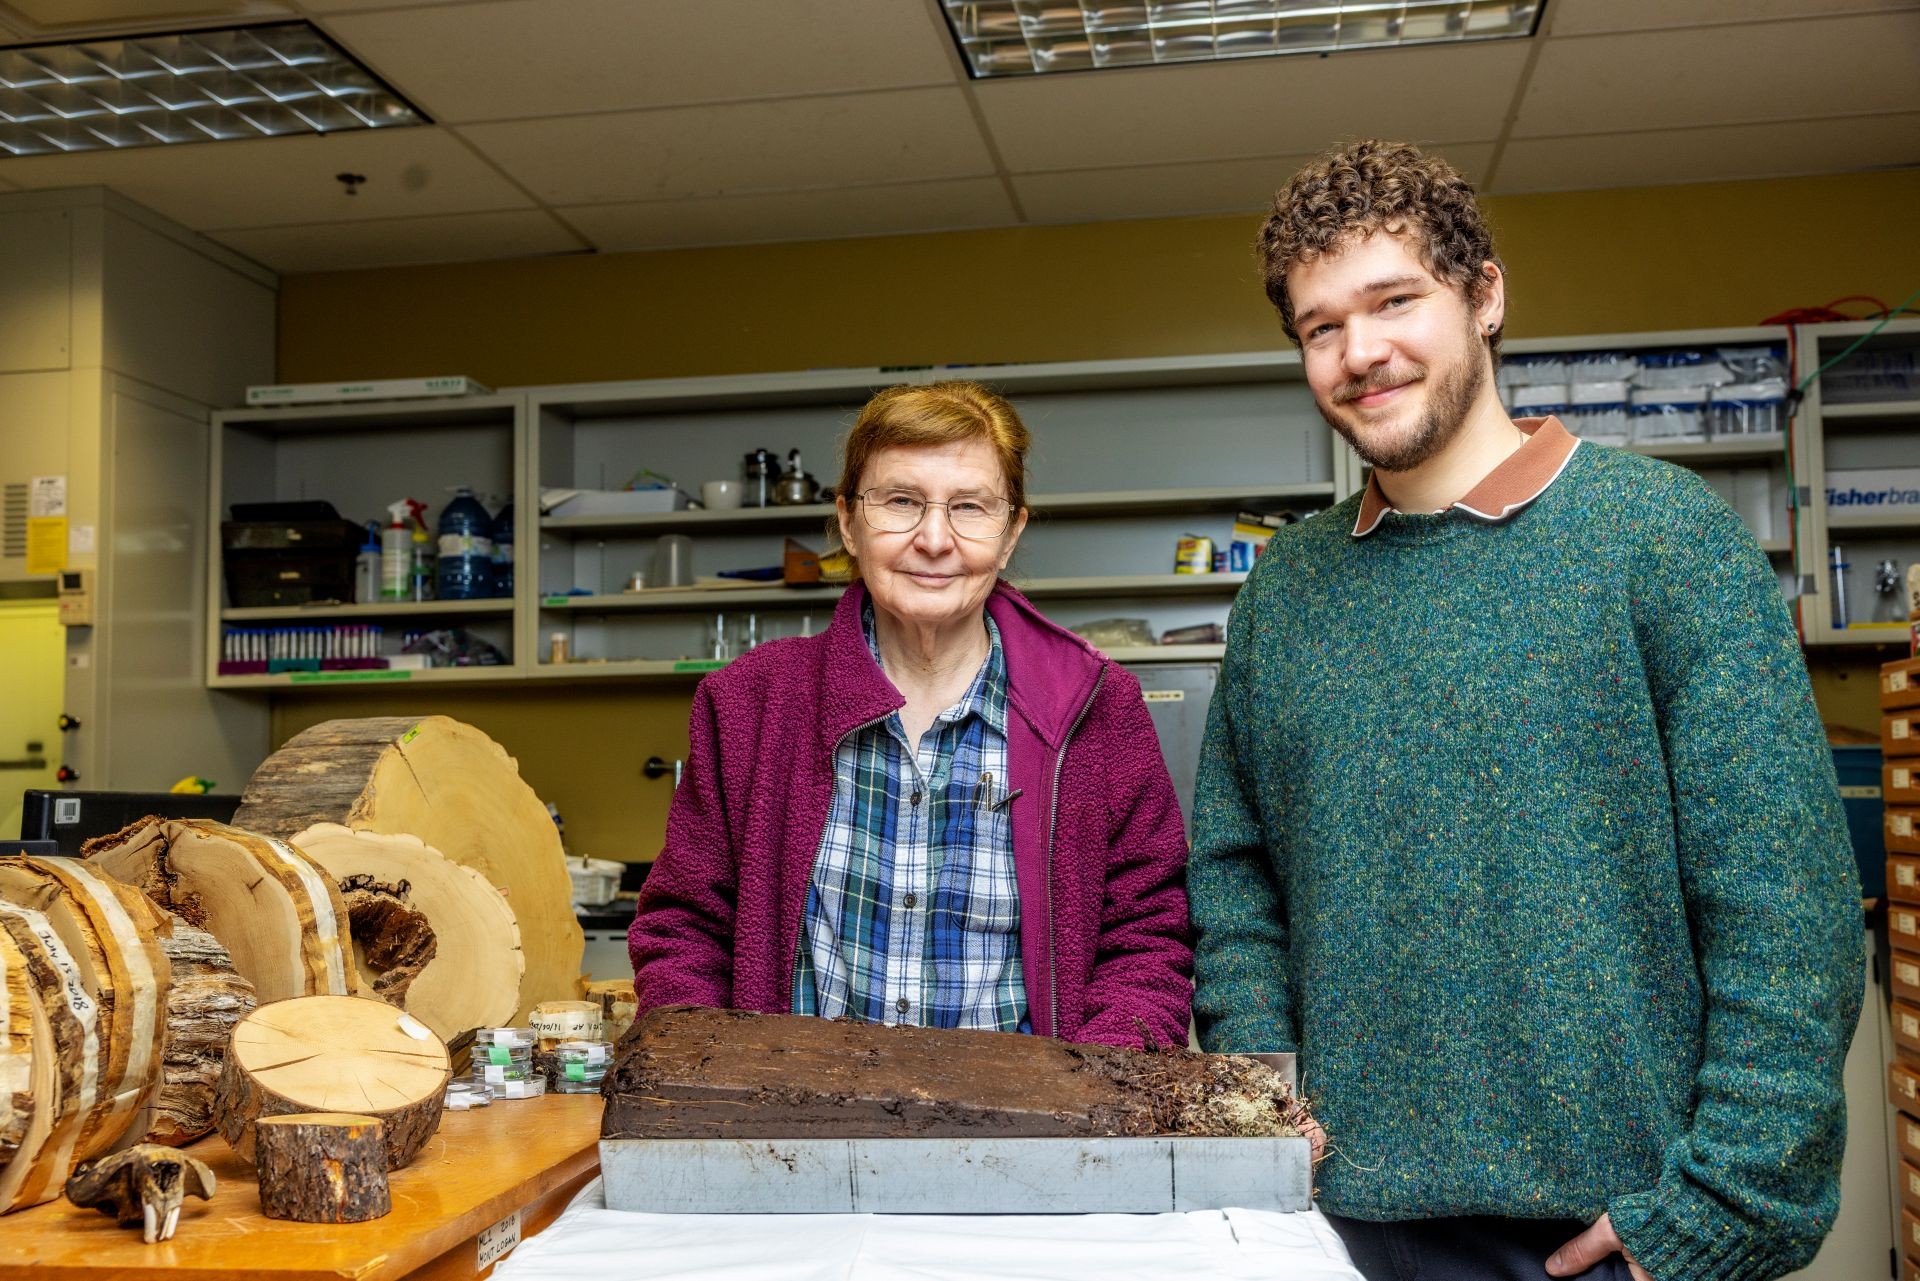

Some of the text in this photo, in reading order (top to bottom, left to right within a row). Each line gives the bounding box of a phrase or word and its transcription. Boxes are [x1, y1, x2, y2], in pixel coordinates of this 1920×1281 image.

[1824, 486, 1920, 506] isherbra
[67, 980, 90, 1011] 2018
[500, 1215, 516, 1232] 2018
[496, 1232, 516, 1253] LOGAN
